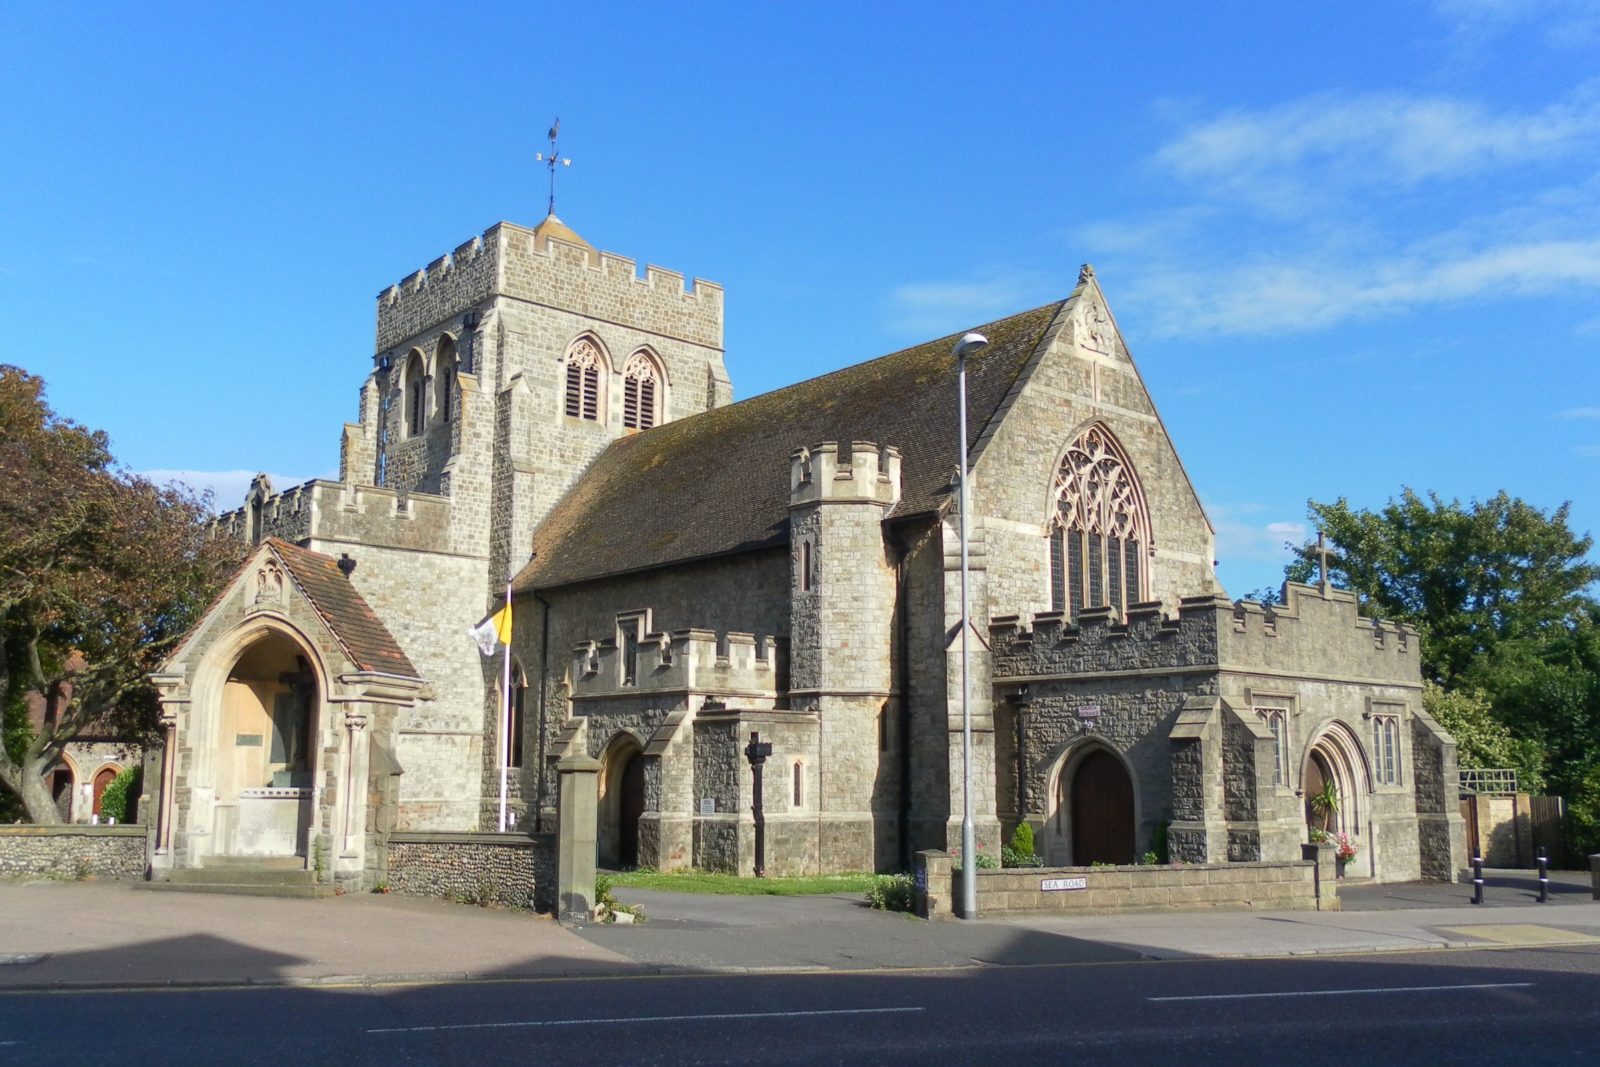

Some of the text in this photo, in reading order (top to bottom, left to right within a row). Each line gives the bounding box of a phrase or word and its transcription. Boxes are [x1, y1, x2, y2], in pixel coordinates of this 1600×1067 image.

[563, 158, 571, 166] W
[1044, 880, 1084, 889] SEA ROAD
